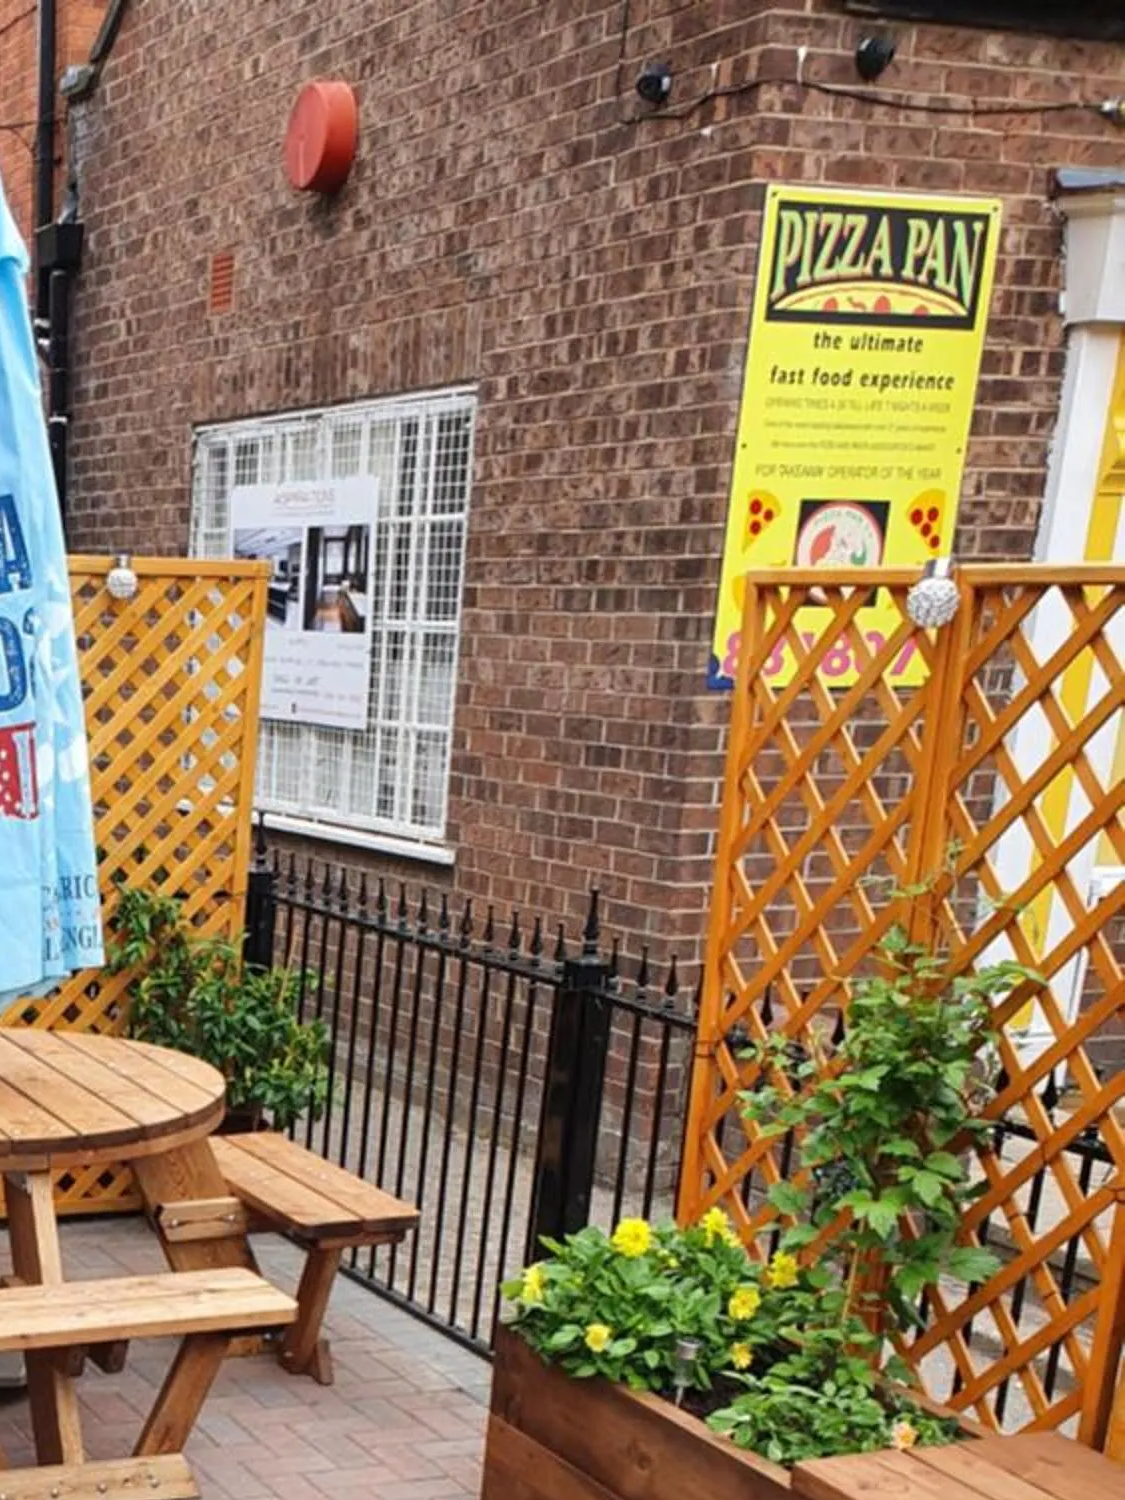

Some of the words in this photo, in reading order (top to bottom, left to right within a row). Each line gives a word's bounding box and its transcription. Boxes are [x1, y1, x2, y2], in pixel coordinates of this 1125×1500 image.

[770, 209, 893, 300] PIZZA
[901, 216, 984, 309] PAN
[813, 331, 843, 350] the
[850, 333, 924, 353] ultimate
[770, 365, 805, 386] fast
[812, 366, 854, 387] food
[859, 371, 956, 393] experience
